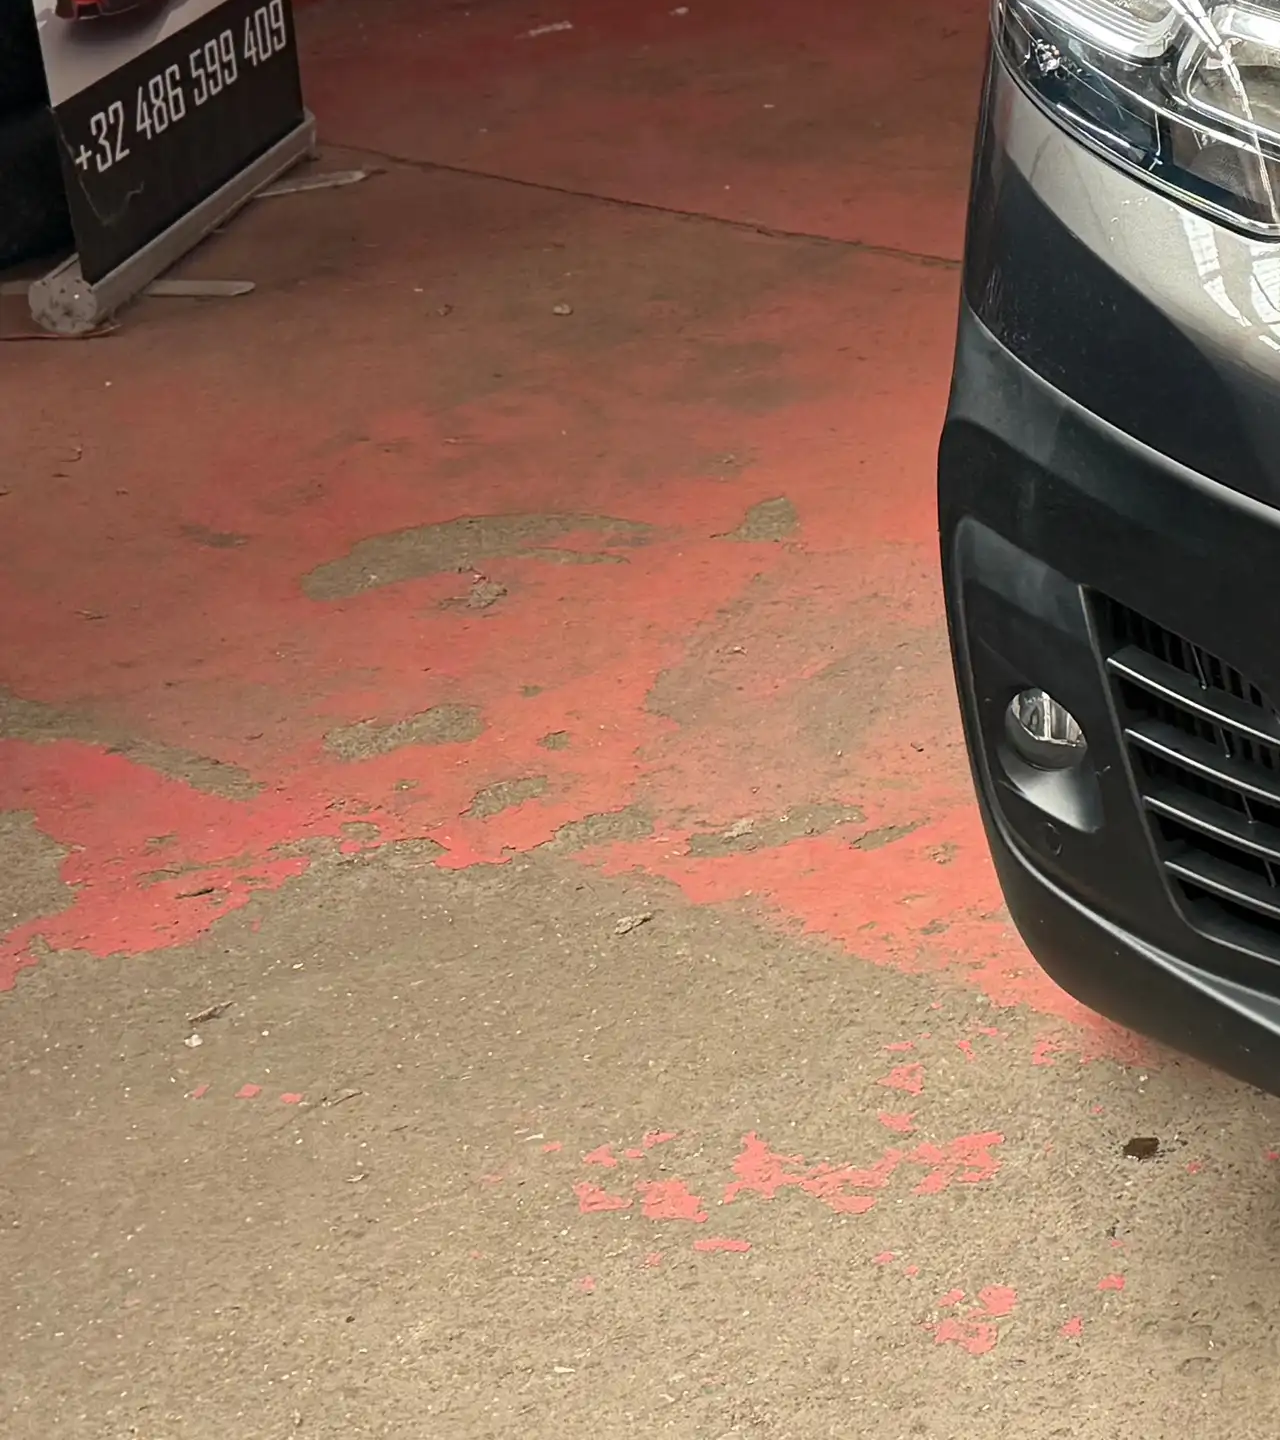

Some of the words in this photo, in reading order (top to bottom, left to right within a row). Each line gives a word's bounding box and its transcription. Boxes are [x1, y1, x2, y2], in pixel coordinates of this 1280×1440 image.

[75, 100, 131, 173] +32
[135, 63, 187, 141] 486
[188, 28, 239, 107] 599
